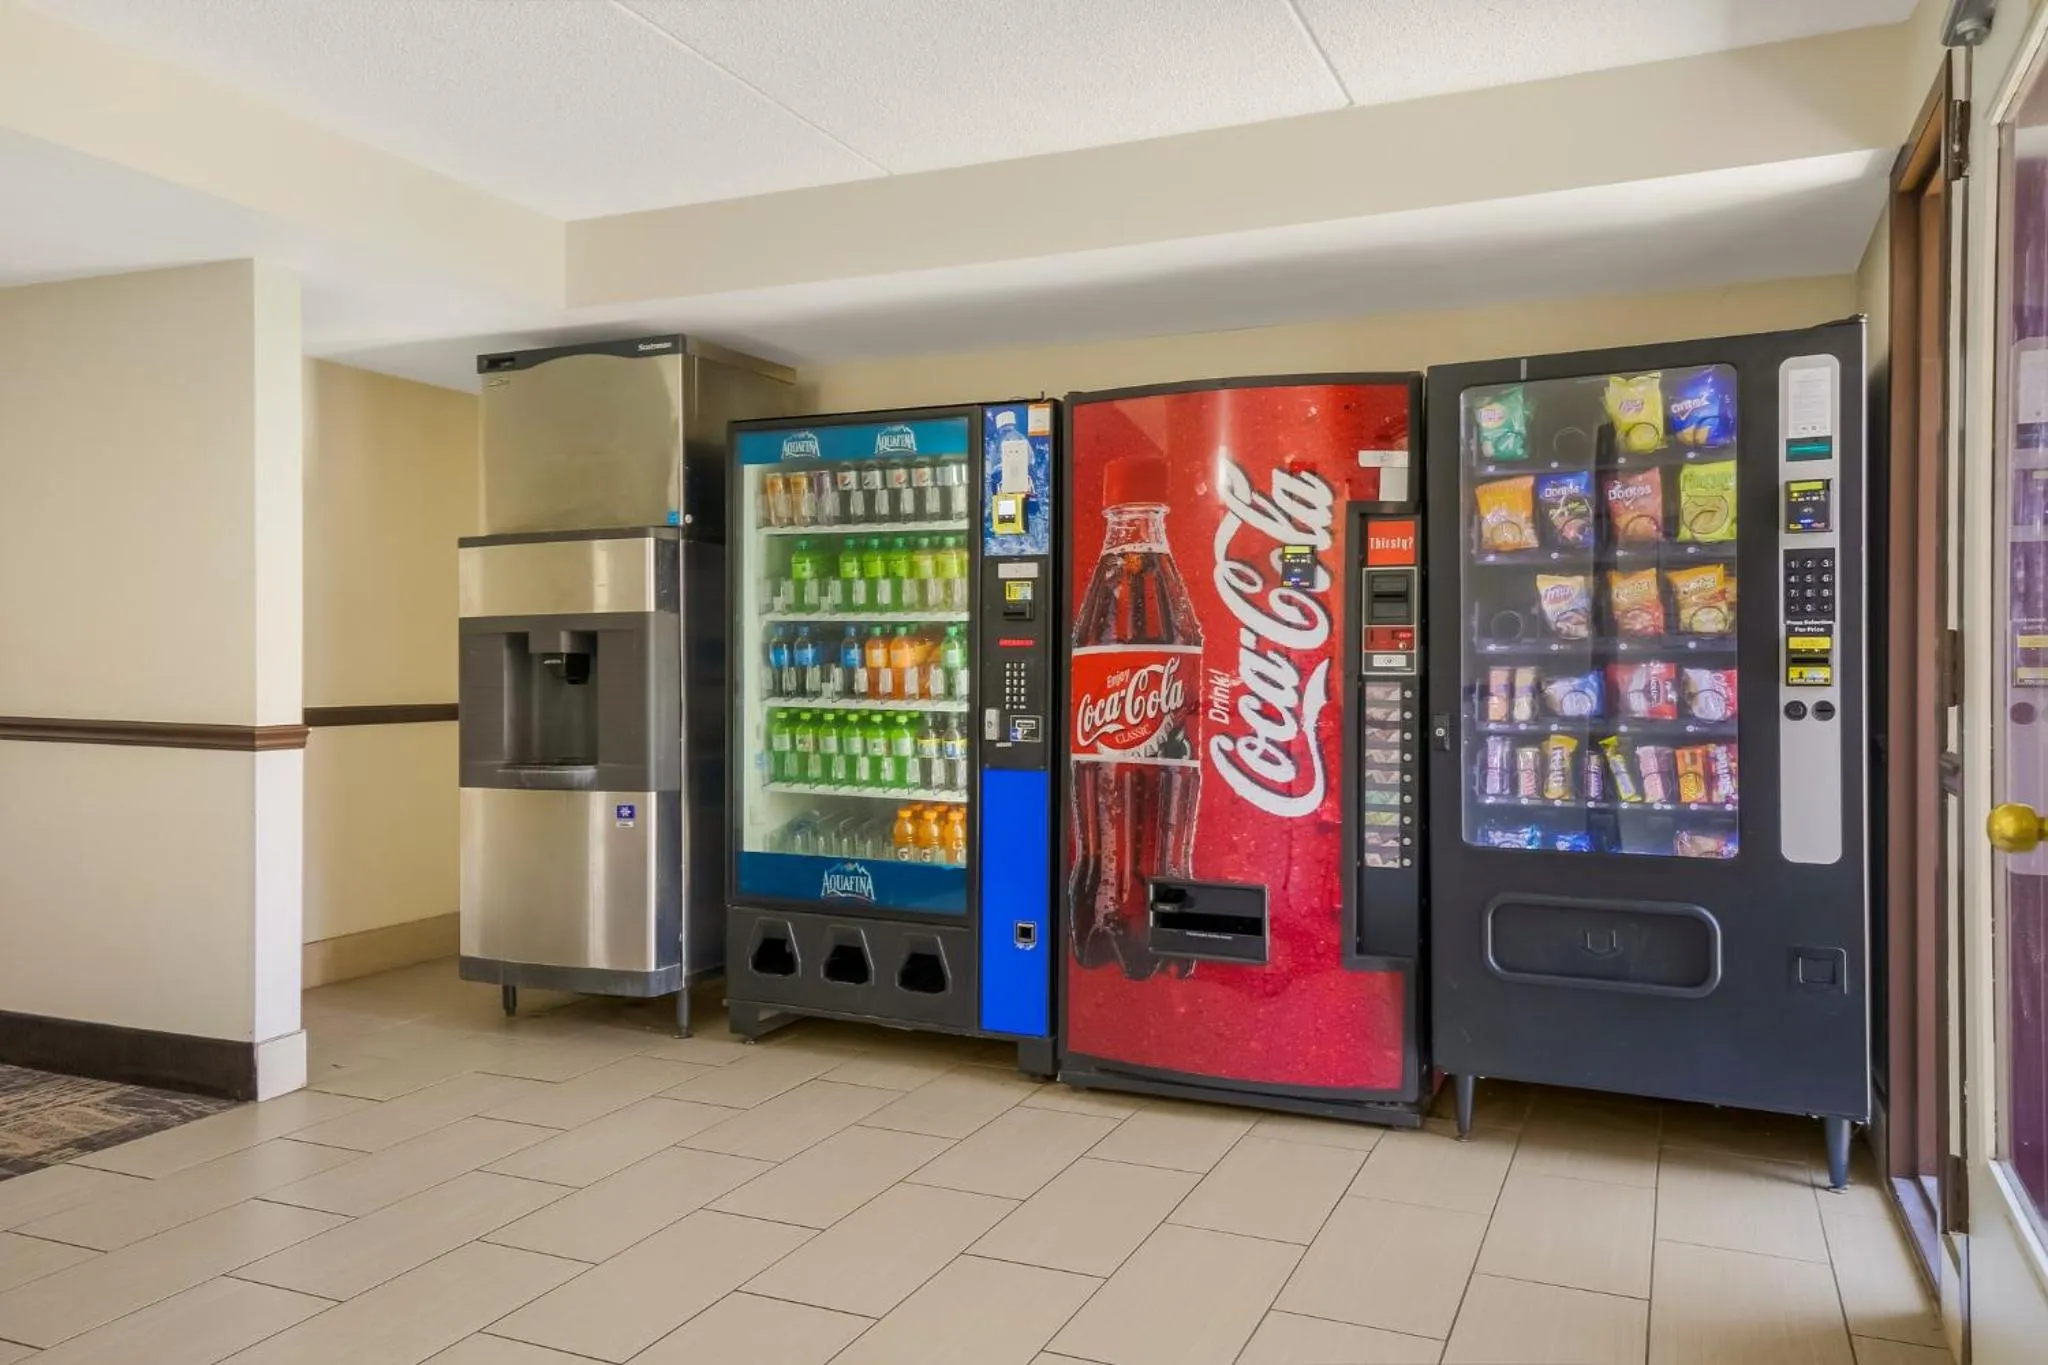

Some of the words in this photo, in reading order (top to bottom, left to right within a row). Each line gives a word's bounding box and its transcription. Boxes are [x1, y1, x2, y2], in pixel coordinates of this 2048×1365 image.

[1369, 535, 1414, 551] Thirsty?
[1106, 668, 1130, 689] Enjoy
[1077, 656, 1184, 747] Coca-Cola
[820, 869, 877, 902] AQUAFINA
